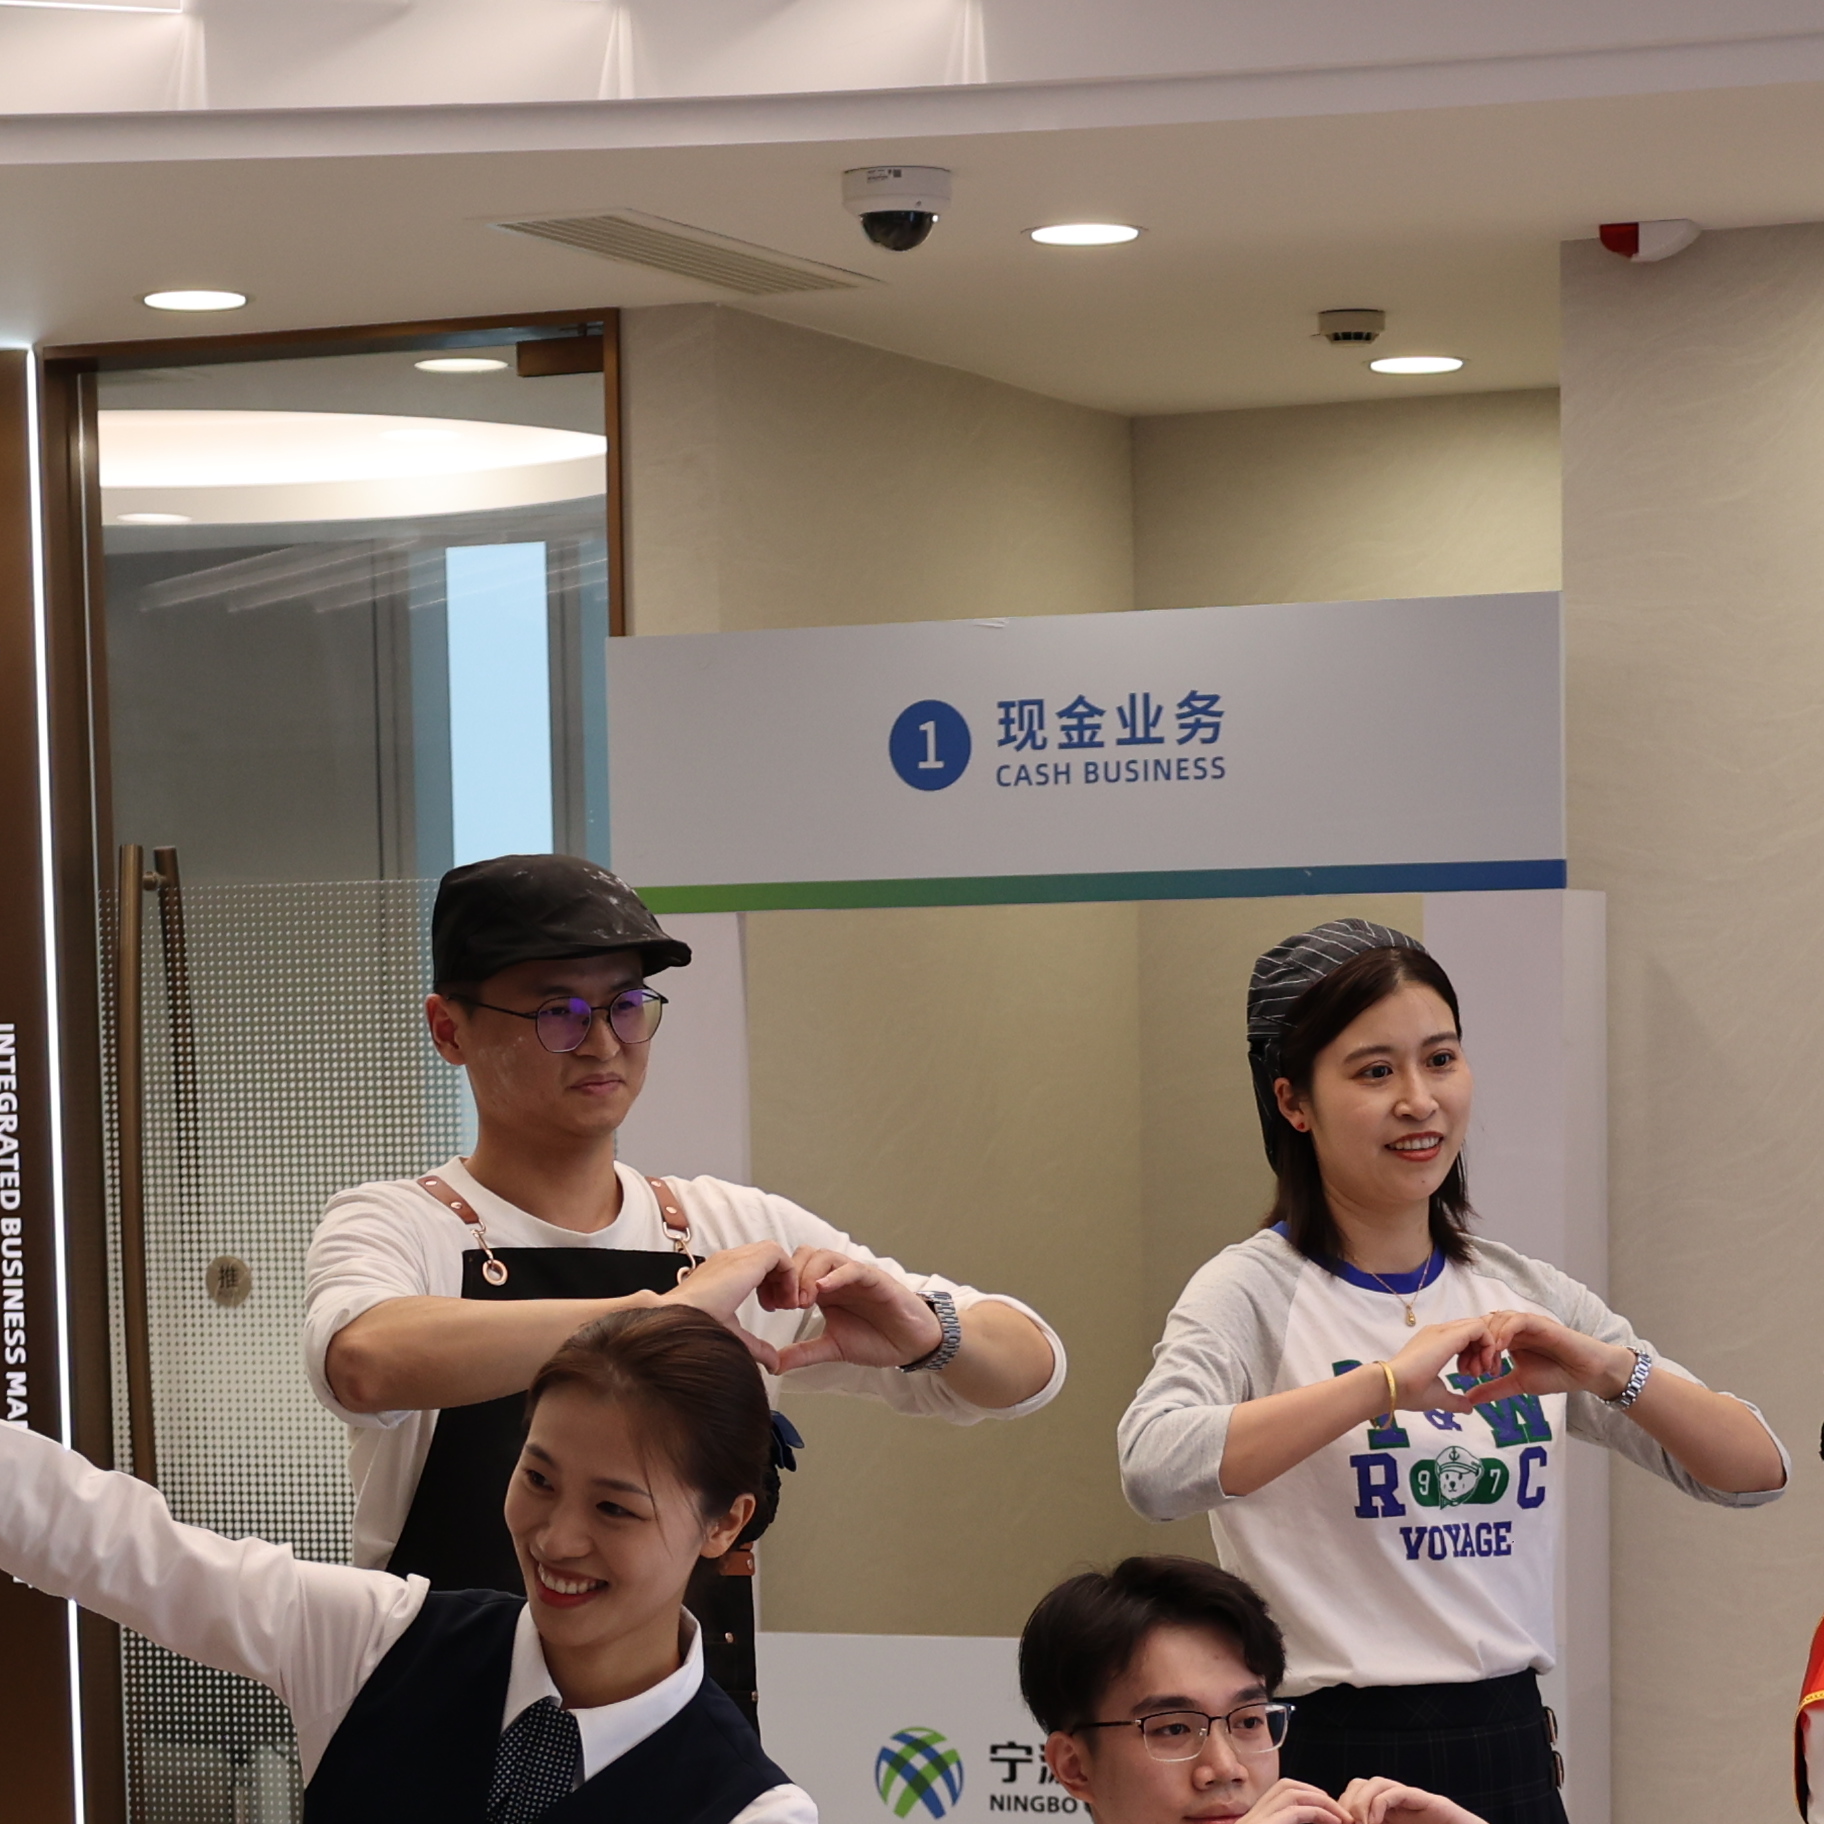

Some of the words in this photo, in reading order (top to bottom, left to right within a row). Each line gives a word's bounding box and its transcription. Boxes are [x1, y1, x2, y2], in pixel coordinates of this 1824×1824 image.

[917, 719, 945, 770] 1
[996, 689, 1226, 753] 现金业务
[995, 761, 1072, 788] CASH
[1083, 756, 1227, 785] BUSINESS
[0, 1216, 27, 1366] BUSINESS
[5, 1370, 29, 1431] MA
[1349, 1452, 1406, 1519] R
[1516, 1446, 1548, 1510] C
[1399, 1520, 1513, 1561] VOYAGE
[989, 1794, 1078, 1814] NINGBO
